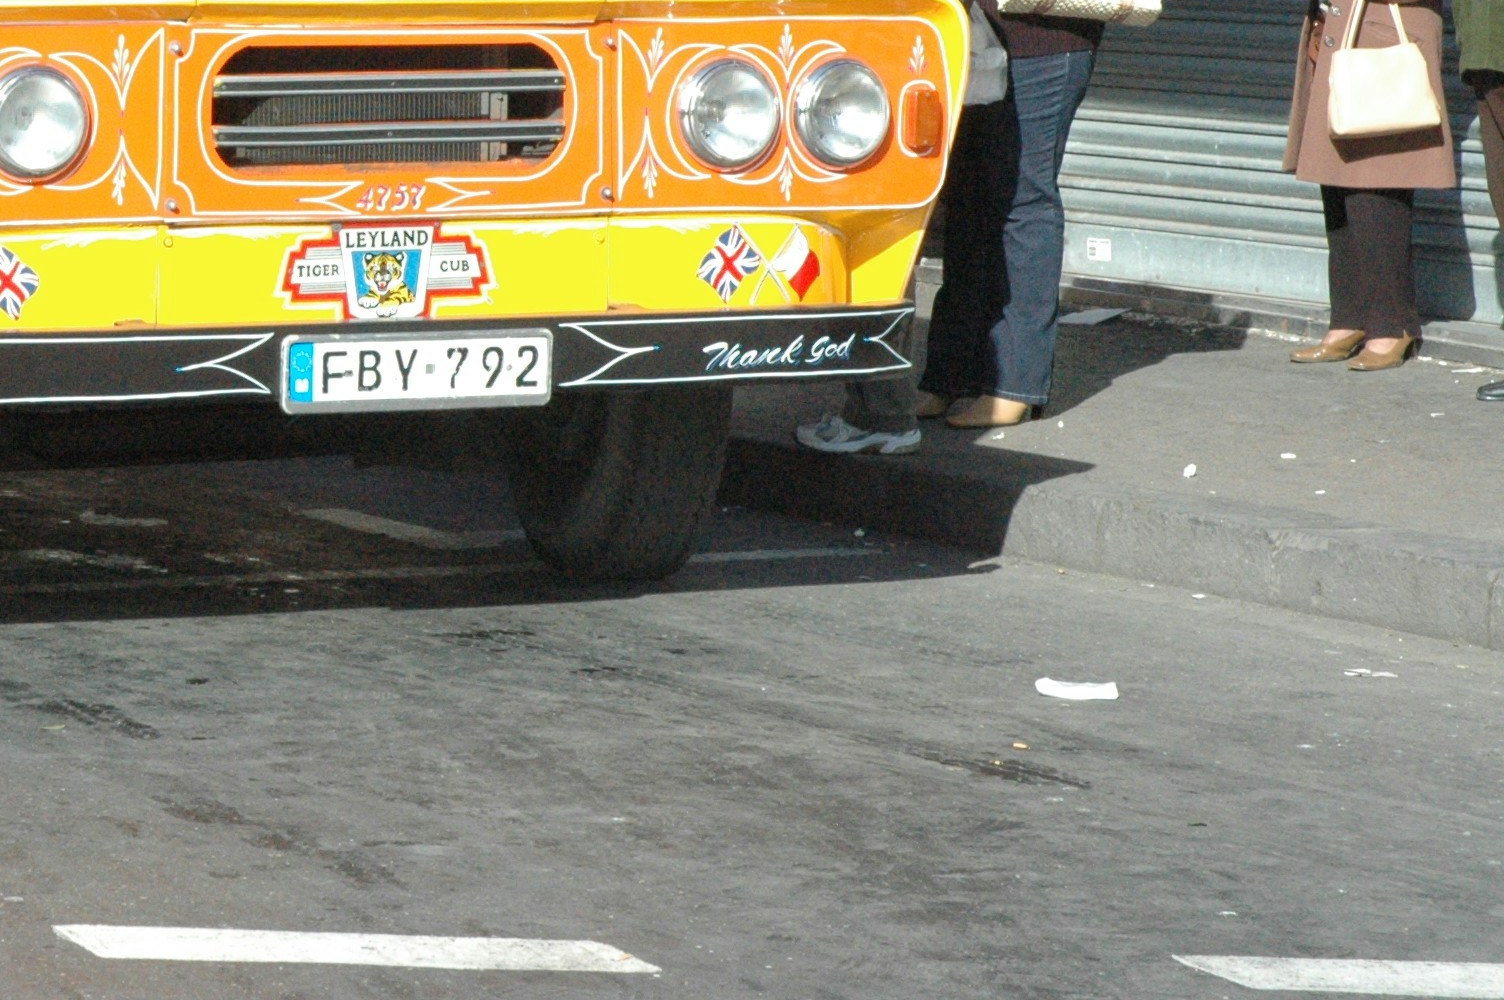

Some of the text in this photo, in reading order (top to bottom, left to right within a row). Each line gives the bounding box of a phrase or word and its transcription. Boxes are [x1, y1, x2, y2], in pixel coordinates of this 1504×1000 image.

[355, 184, 427, 212] 4757
[345, 229, 429, 249] LEYLAND
[297, 264, 340, 278] TIGER
[440, 259, 470, 273] CUB
[703, 333, 857, 371] Thank God
